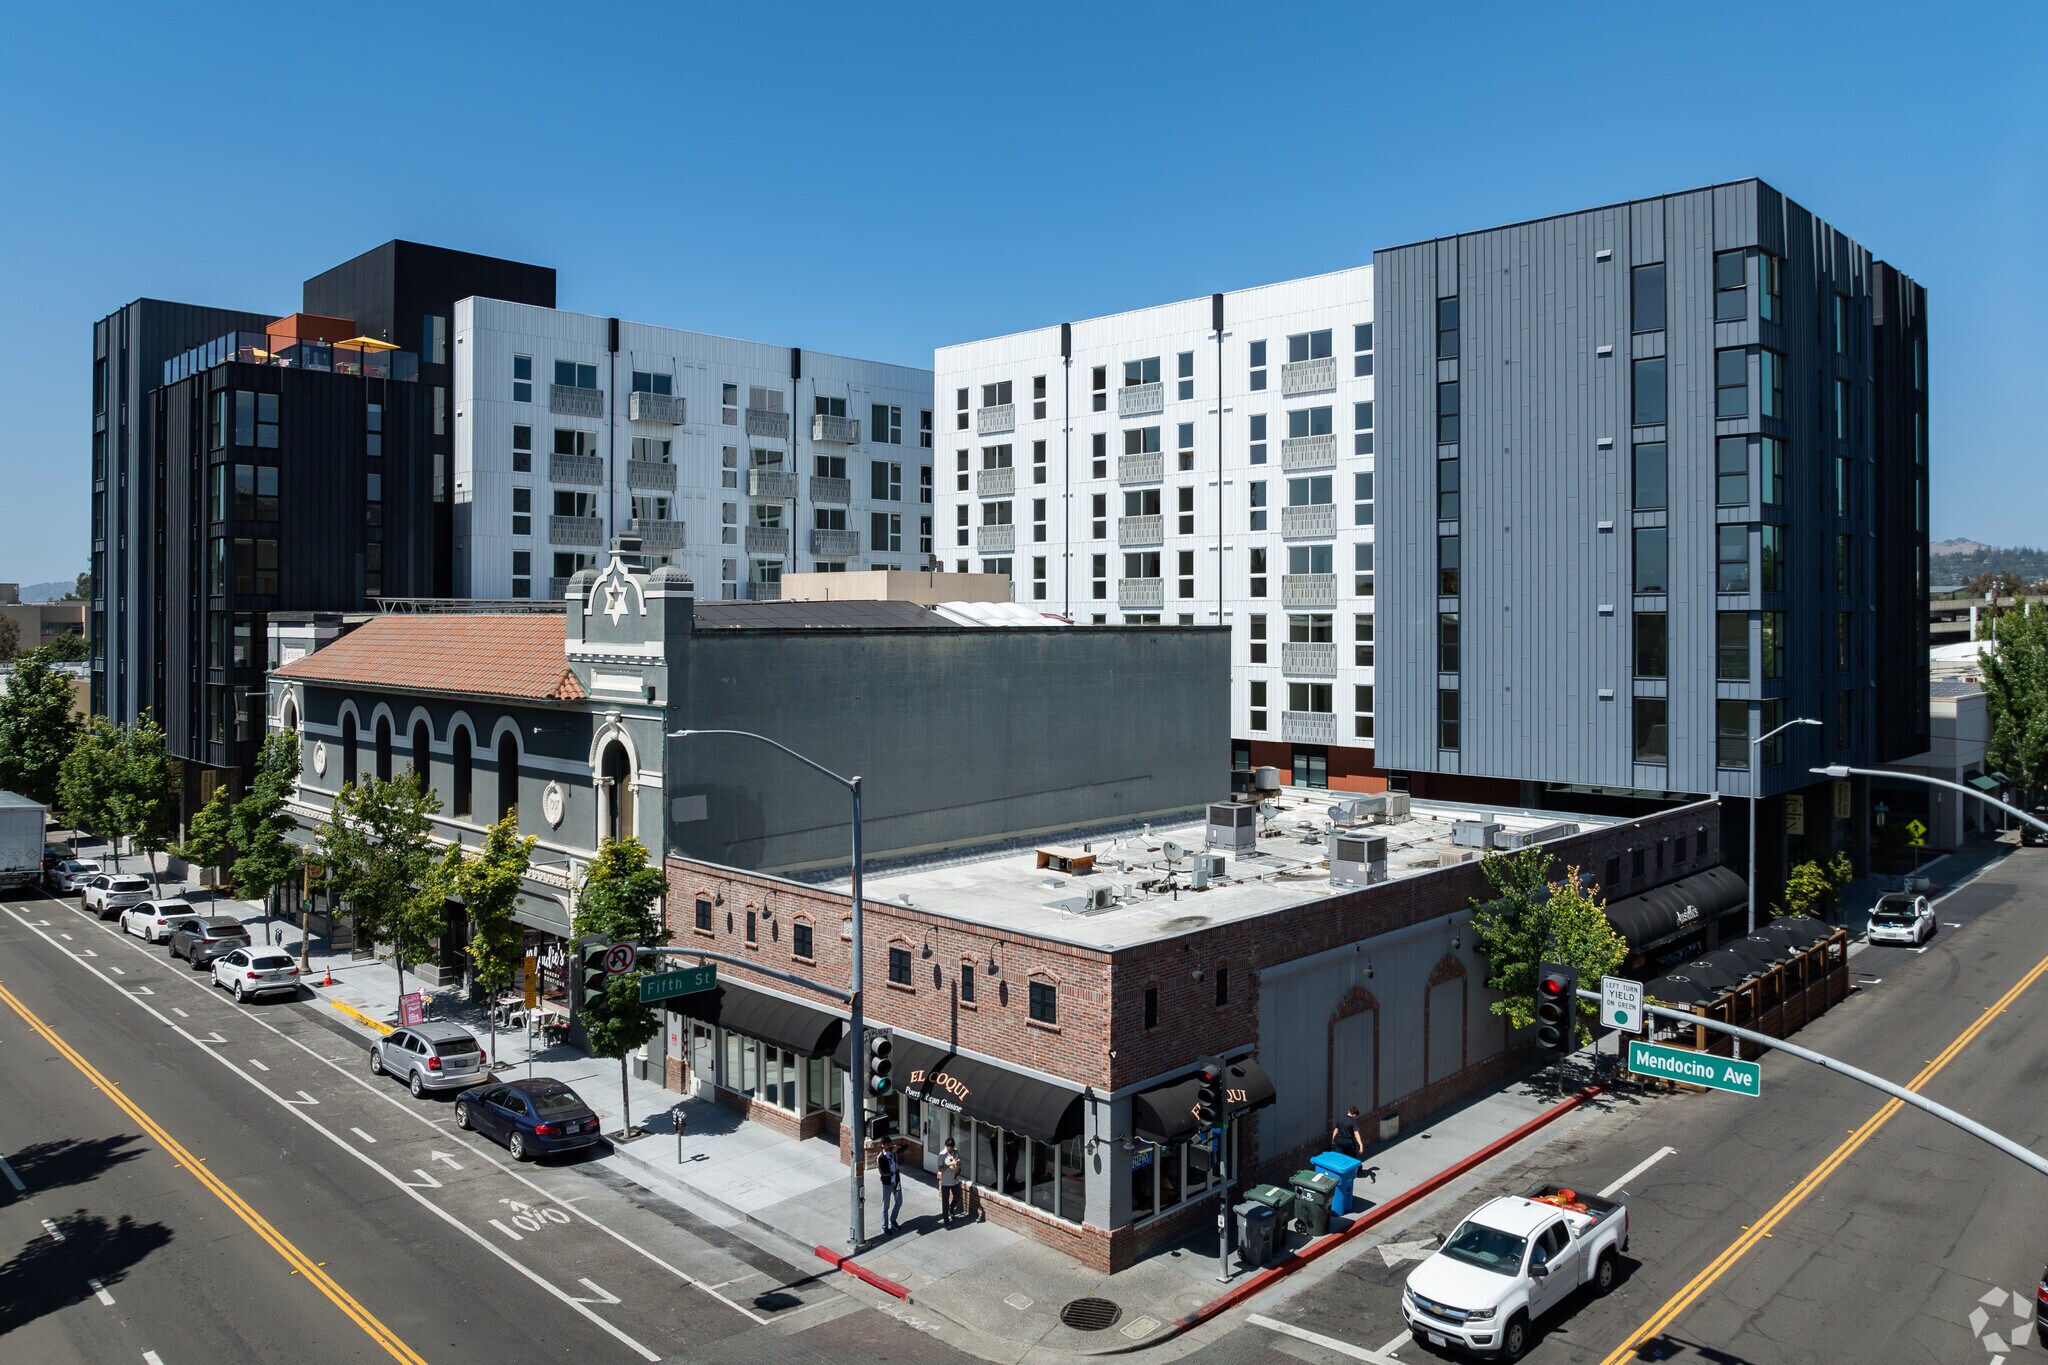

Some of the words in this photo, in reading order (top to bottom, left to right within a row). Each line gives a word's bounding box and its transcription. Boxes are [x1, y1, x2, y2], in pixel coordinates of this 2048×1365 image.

[647, 978, 682, 995] Fifth
[695, 972, 710, 985] St
[1605, 981, 1619, 989] LEFT
[1623, 985, 1638, 993] TURN
[1609, 990, 1635, 1001] YIELD
[1617, 1001, 1637, 1010] GREEN
[1636, 1050, 1714, 1079] Mendocino
[1722, 1067, 1753, 1086] Ave
[910, 1070, 926, 1083] EL
[928, 1072, 970, 1101] COQUI
[905, 1085, 922, 1098] Puerto
[940, 1098, 963, 1113] Cuisine
[1226, 1088, 1247, 1103] QUI
